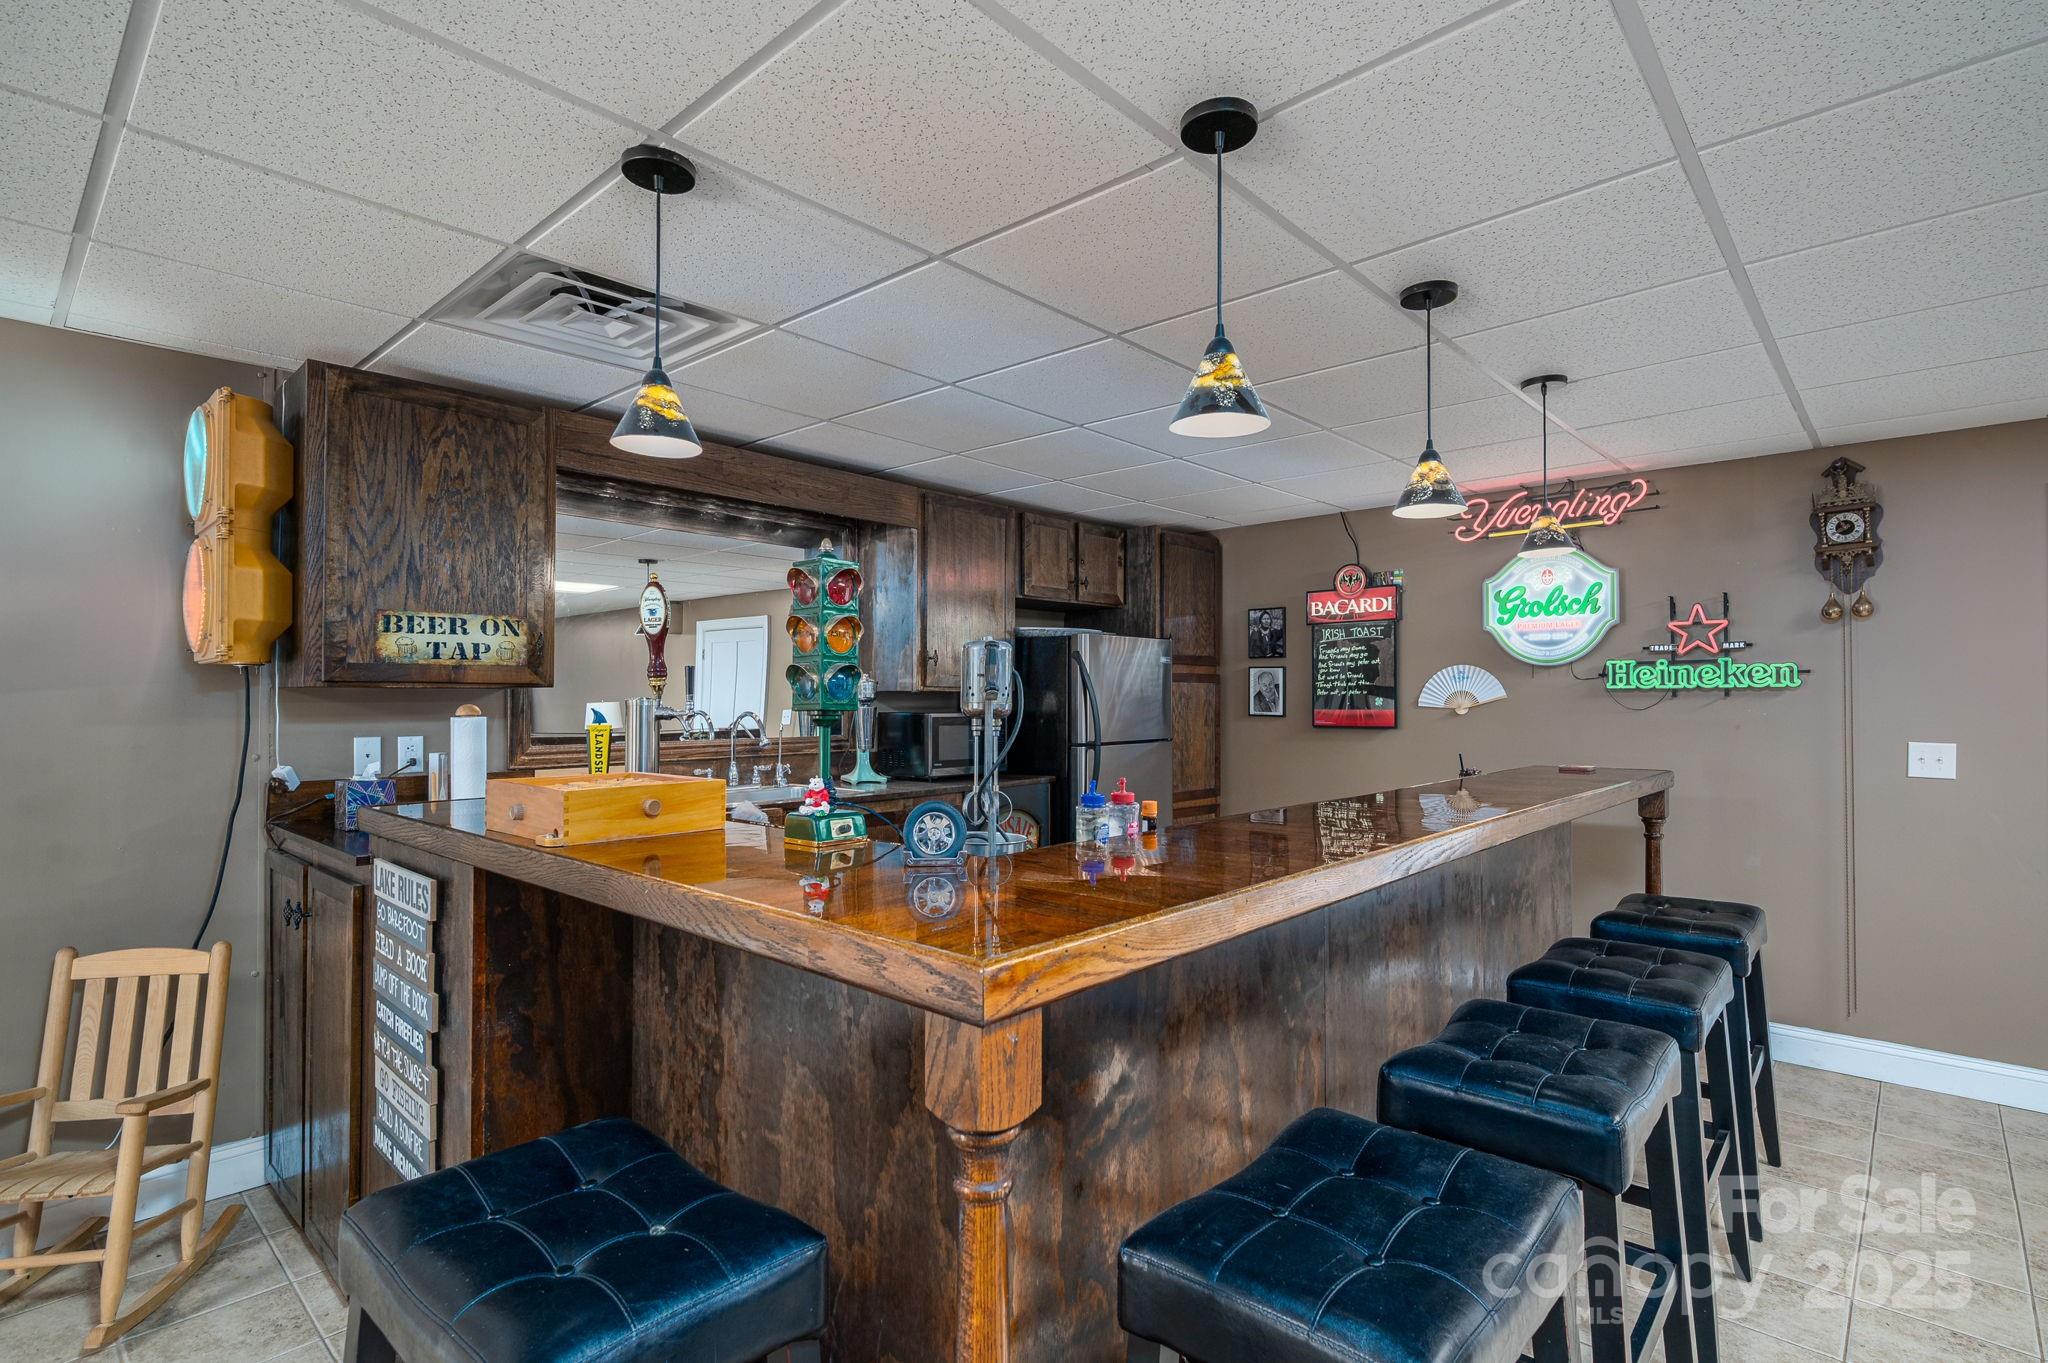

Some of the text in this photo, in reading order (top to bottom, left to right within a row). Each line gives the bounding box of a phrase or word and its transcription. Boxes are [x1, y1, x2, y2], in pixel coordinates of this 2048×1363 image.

[382, 614, 521, 637] BEER ON
[1311, 596, 1393, 616] BACARDI
[1494, 581, 1603, 625] Grolsch
[426, 641, 491, 660] TAP
[1322, 626, 1384, 640] IRISH TOAST
[1650, 641, 1745, 652] TRADE MARK
[1606, 657, 1802, 689] Heineken
[375, 864, 429, 914] LAKE RULES
[377, 901, 425, 943] GO BAREFOOT
[375, 930, 427, 983] READ A BOOK
[375, 964, 428, 1021] JUMP OFF THE DOCK
[376, 999, 423, 1054] CATCH FIREFLIES
[391, 1046, 403, 1074] THE
[403, 1055, 429, 1096] SUNSET
[379, 1067, 424, 1127] GO FISHING
[374, 1124, 422, 1180] MAKE MEMO
[378, 1096, 423, 1162] BUILD A BONFIRE
